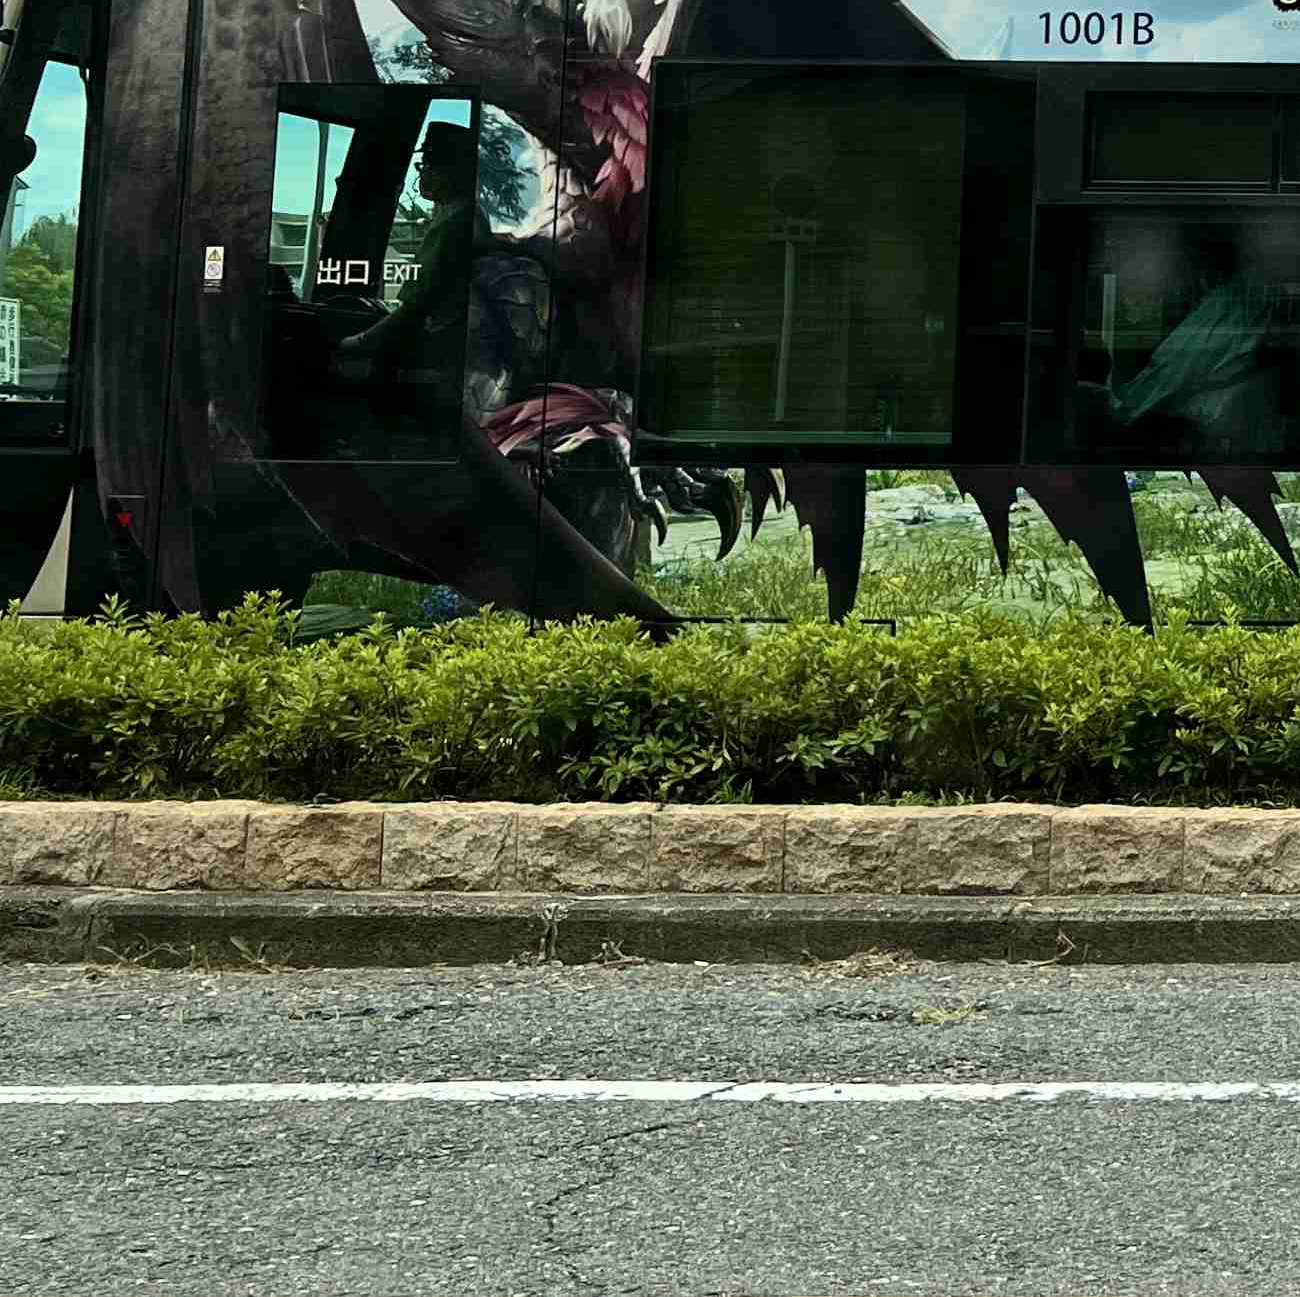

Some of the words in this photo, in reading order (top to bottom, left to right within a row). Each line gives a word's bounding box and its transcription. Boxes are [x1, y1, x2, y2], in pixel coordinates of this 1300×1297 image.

[1038, 11, 1155, 45] 1001B
[316, 257, 370, 285] 出口
[383, 263, 422, 281] EXIT
